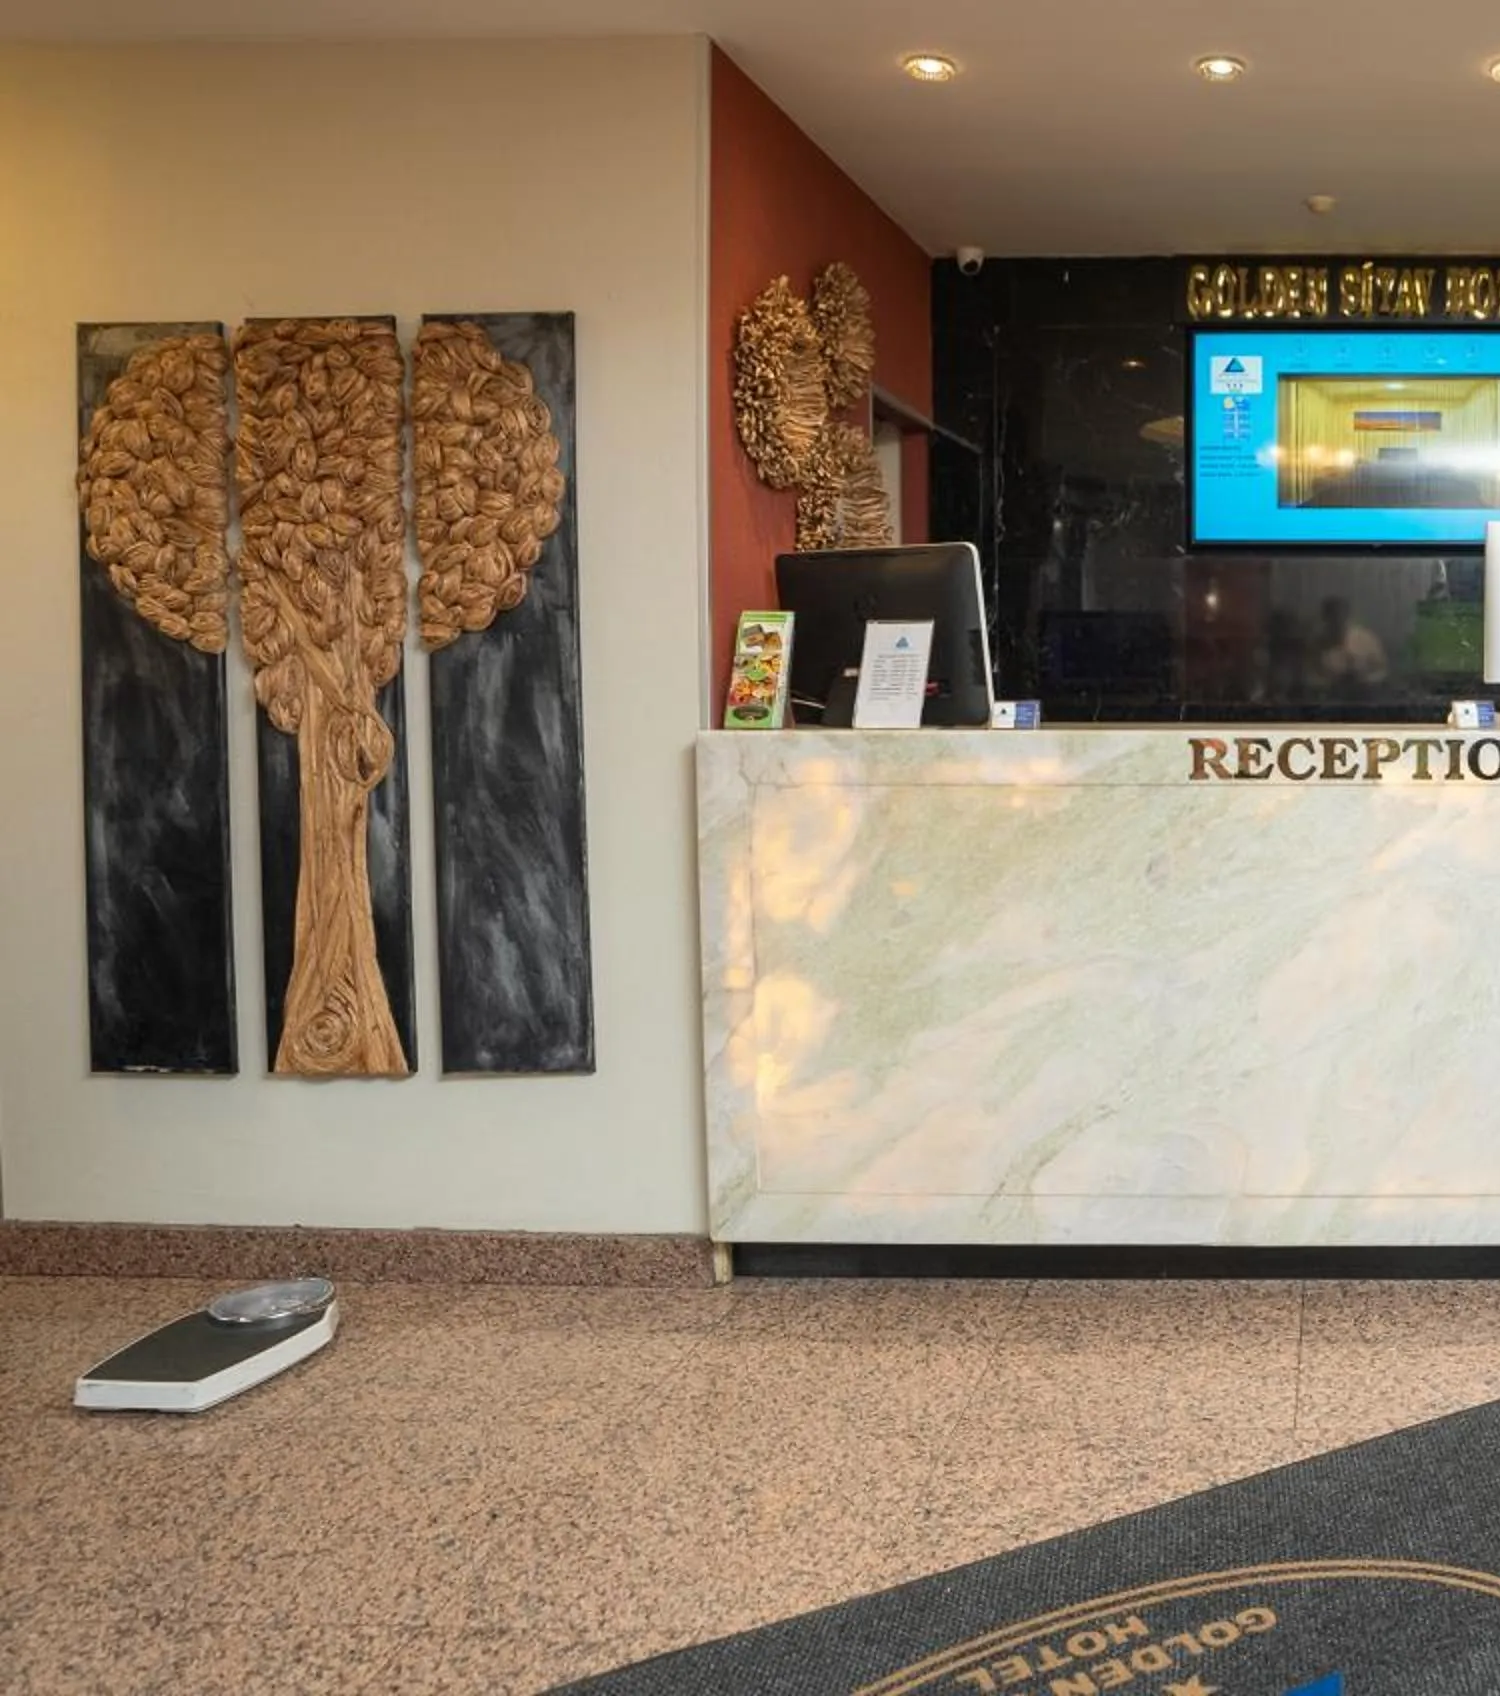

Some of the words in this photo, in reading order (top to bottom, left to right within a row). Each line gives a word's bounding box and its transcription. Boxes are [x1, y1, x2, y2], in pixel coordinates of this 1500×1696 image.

[1187, 264, 1327, 319] GOLDEN
[956, 1616, 1149, 1692] HOTEL
[1050, 1607, 1277, 1696] GOLDEN
